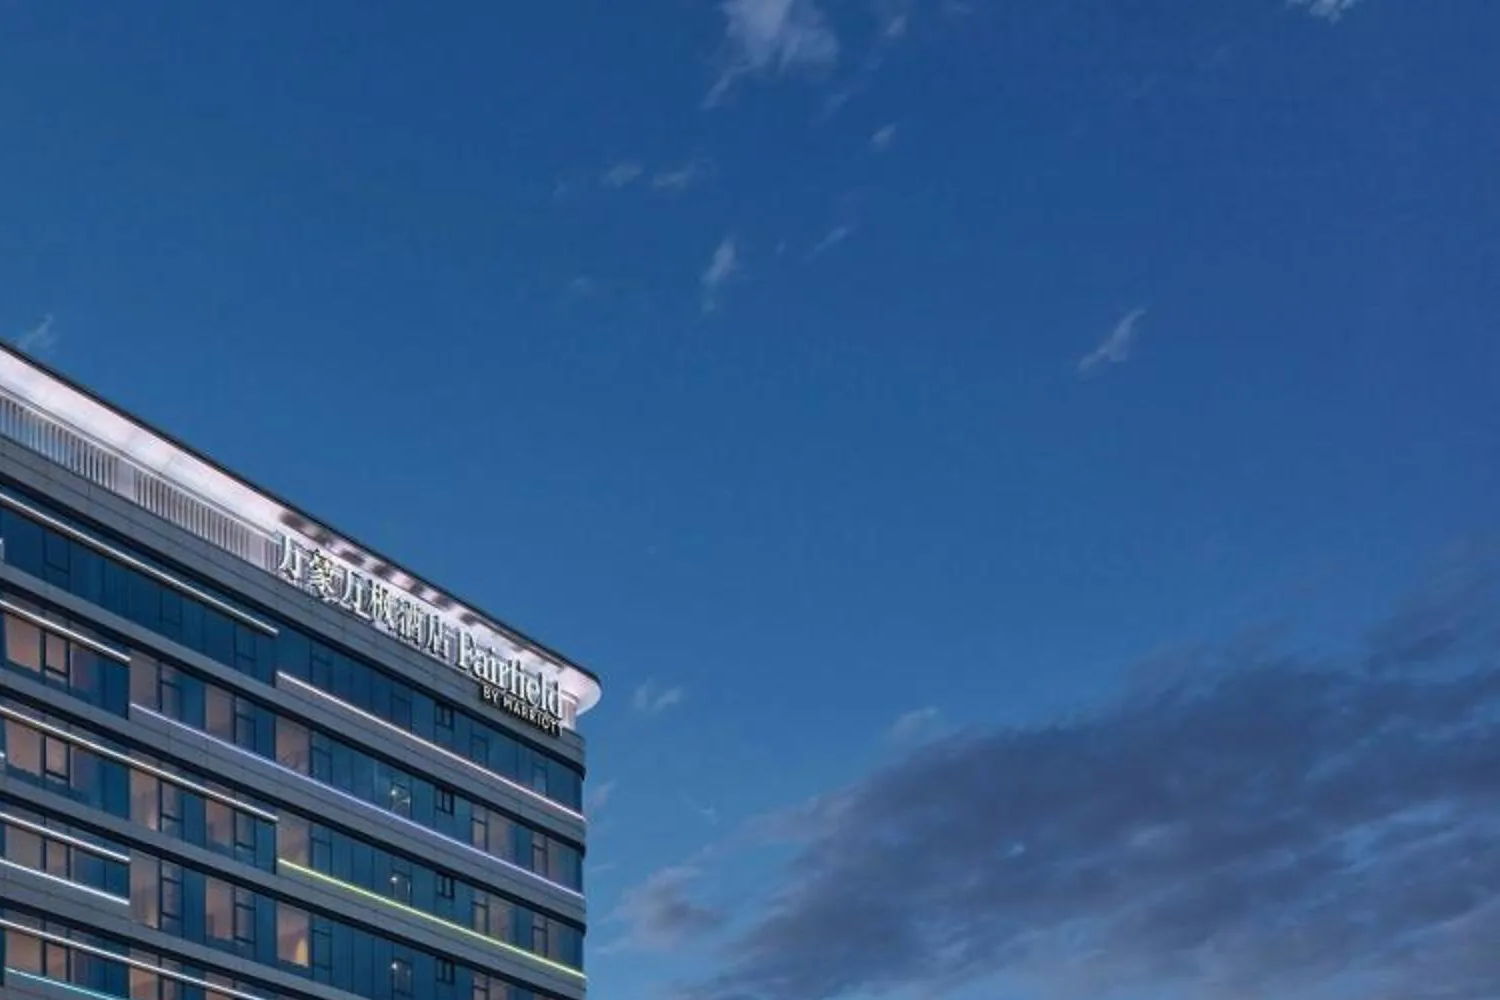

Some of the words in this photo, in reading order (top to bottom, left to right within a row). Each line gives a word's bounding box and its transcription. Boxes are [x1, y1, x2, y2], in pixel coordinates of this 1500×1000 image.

[457, 627, 563, 720] Fairfield
[483, 684, 499, 703] BY
[503, 693, 563, 737] MARRIOTT
